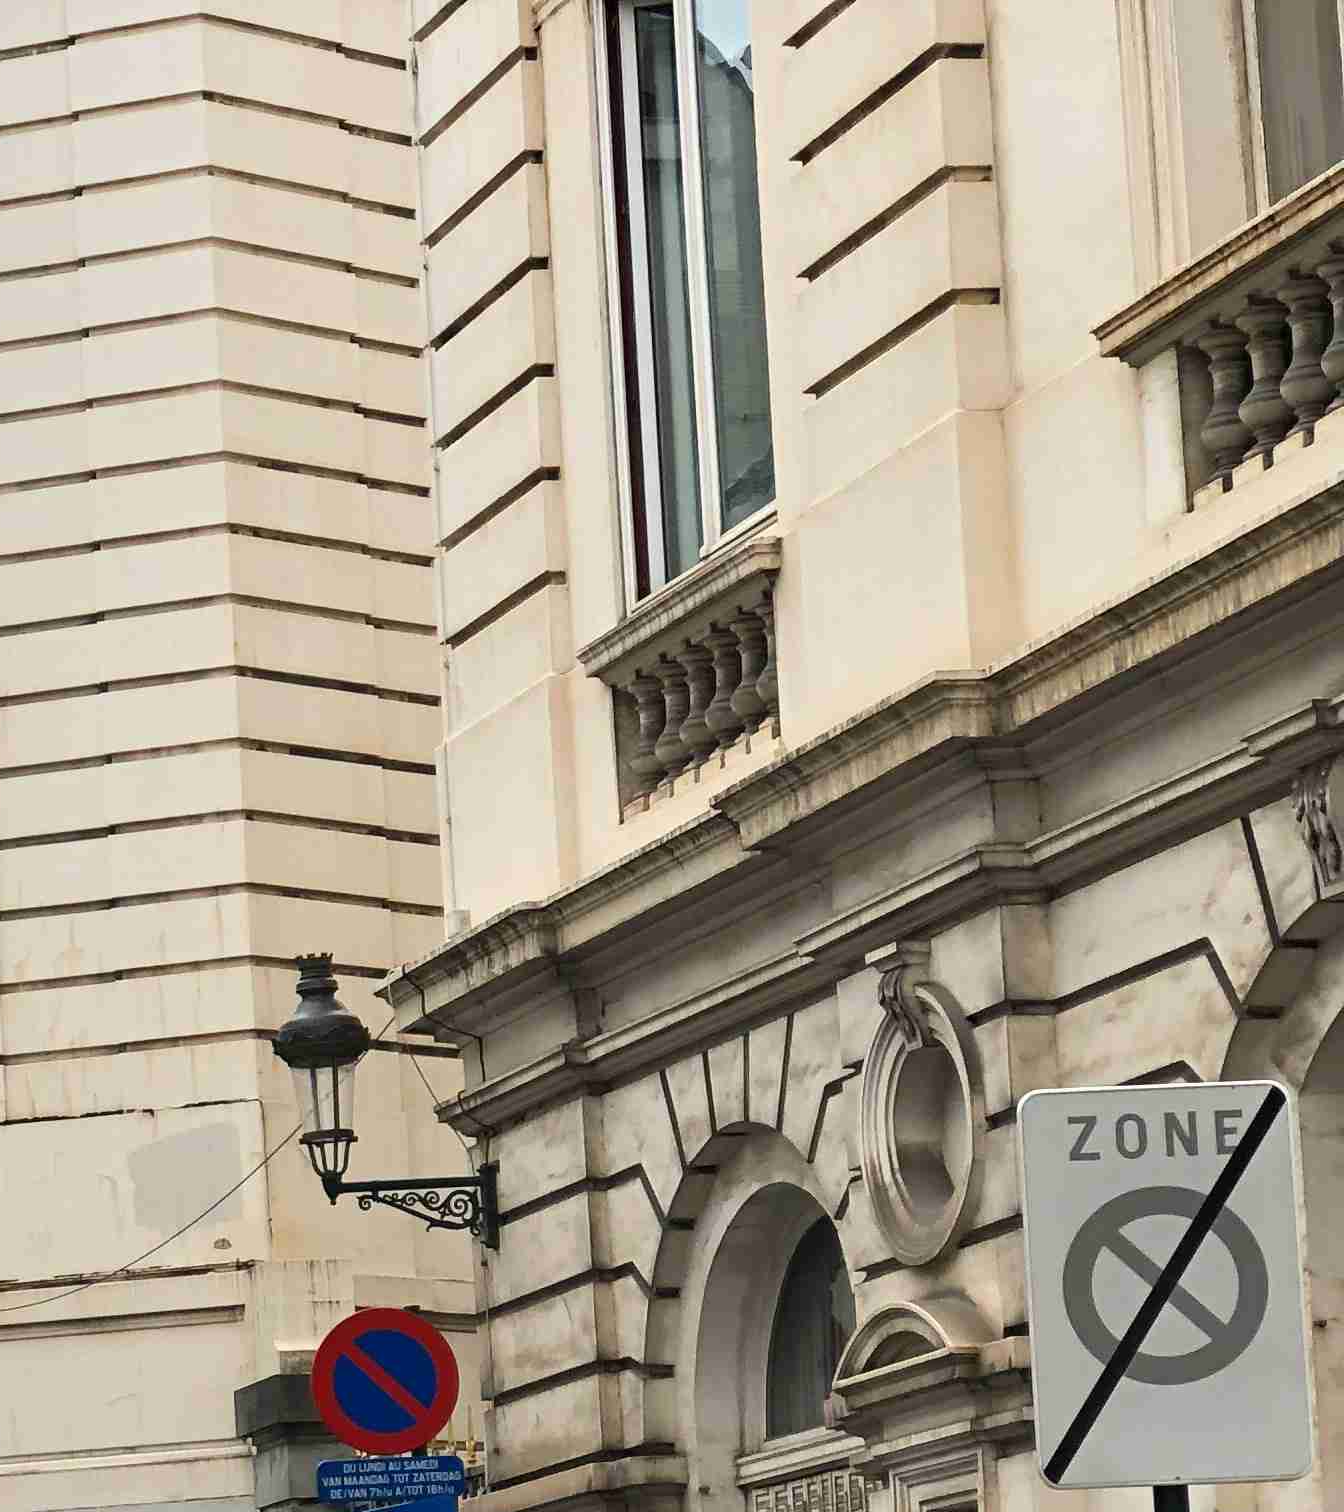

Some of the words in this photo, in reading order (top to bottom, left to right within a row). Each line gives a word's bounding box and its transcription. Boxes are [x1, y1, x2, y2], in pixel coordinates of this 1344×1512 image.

[1067, 1107, 1245, 1162] ZONE
[343, 1463, 356, 1473] DU
[359, 1462, 386, 1472] LUNDI
[388, 1461, 402, 1471] AU
[403, 1459, 439, 1471] SAMEDI
[321, 1476, 342, 1486] VAN
[343, 1474, 390, 1485] MAANDAG
[393, 1473, 410, 1483] TOT
[412, 1471, 461, 1482] ZATERDAG
[330, 1487, 367, 1499] DE/VAN
